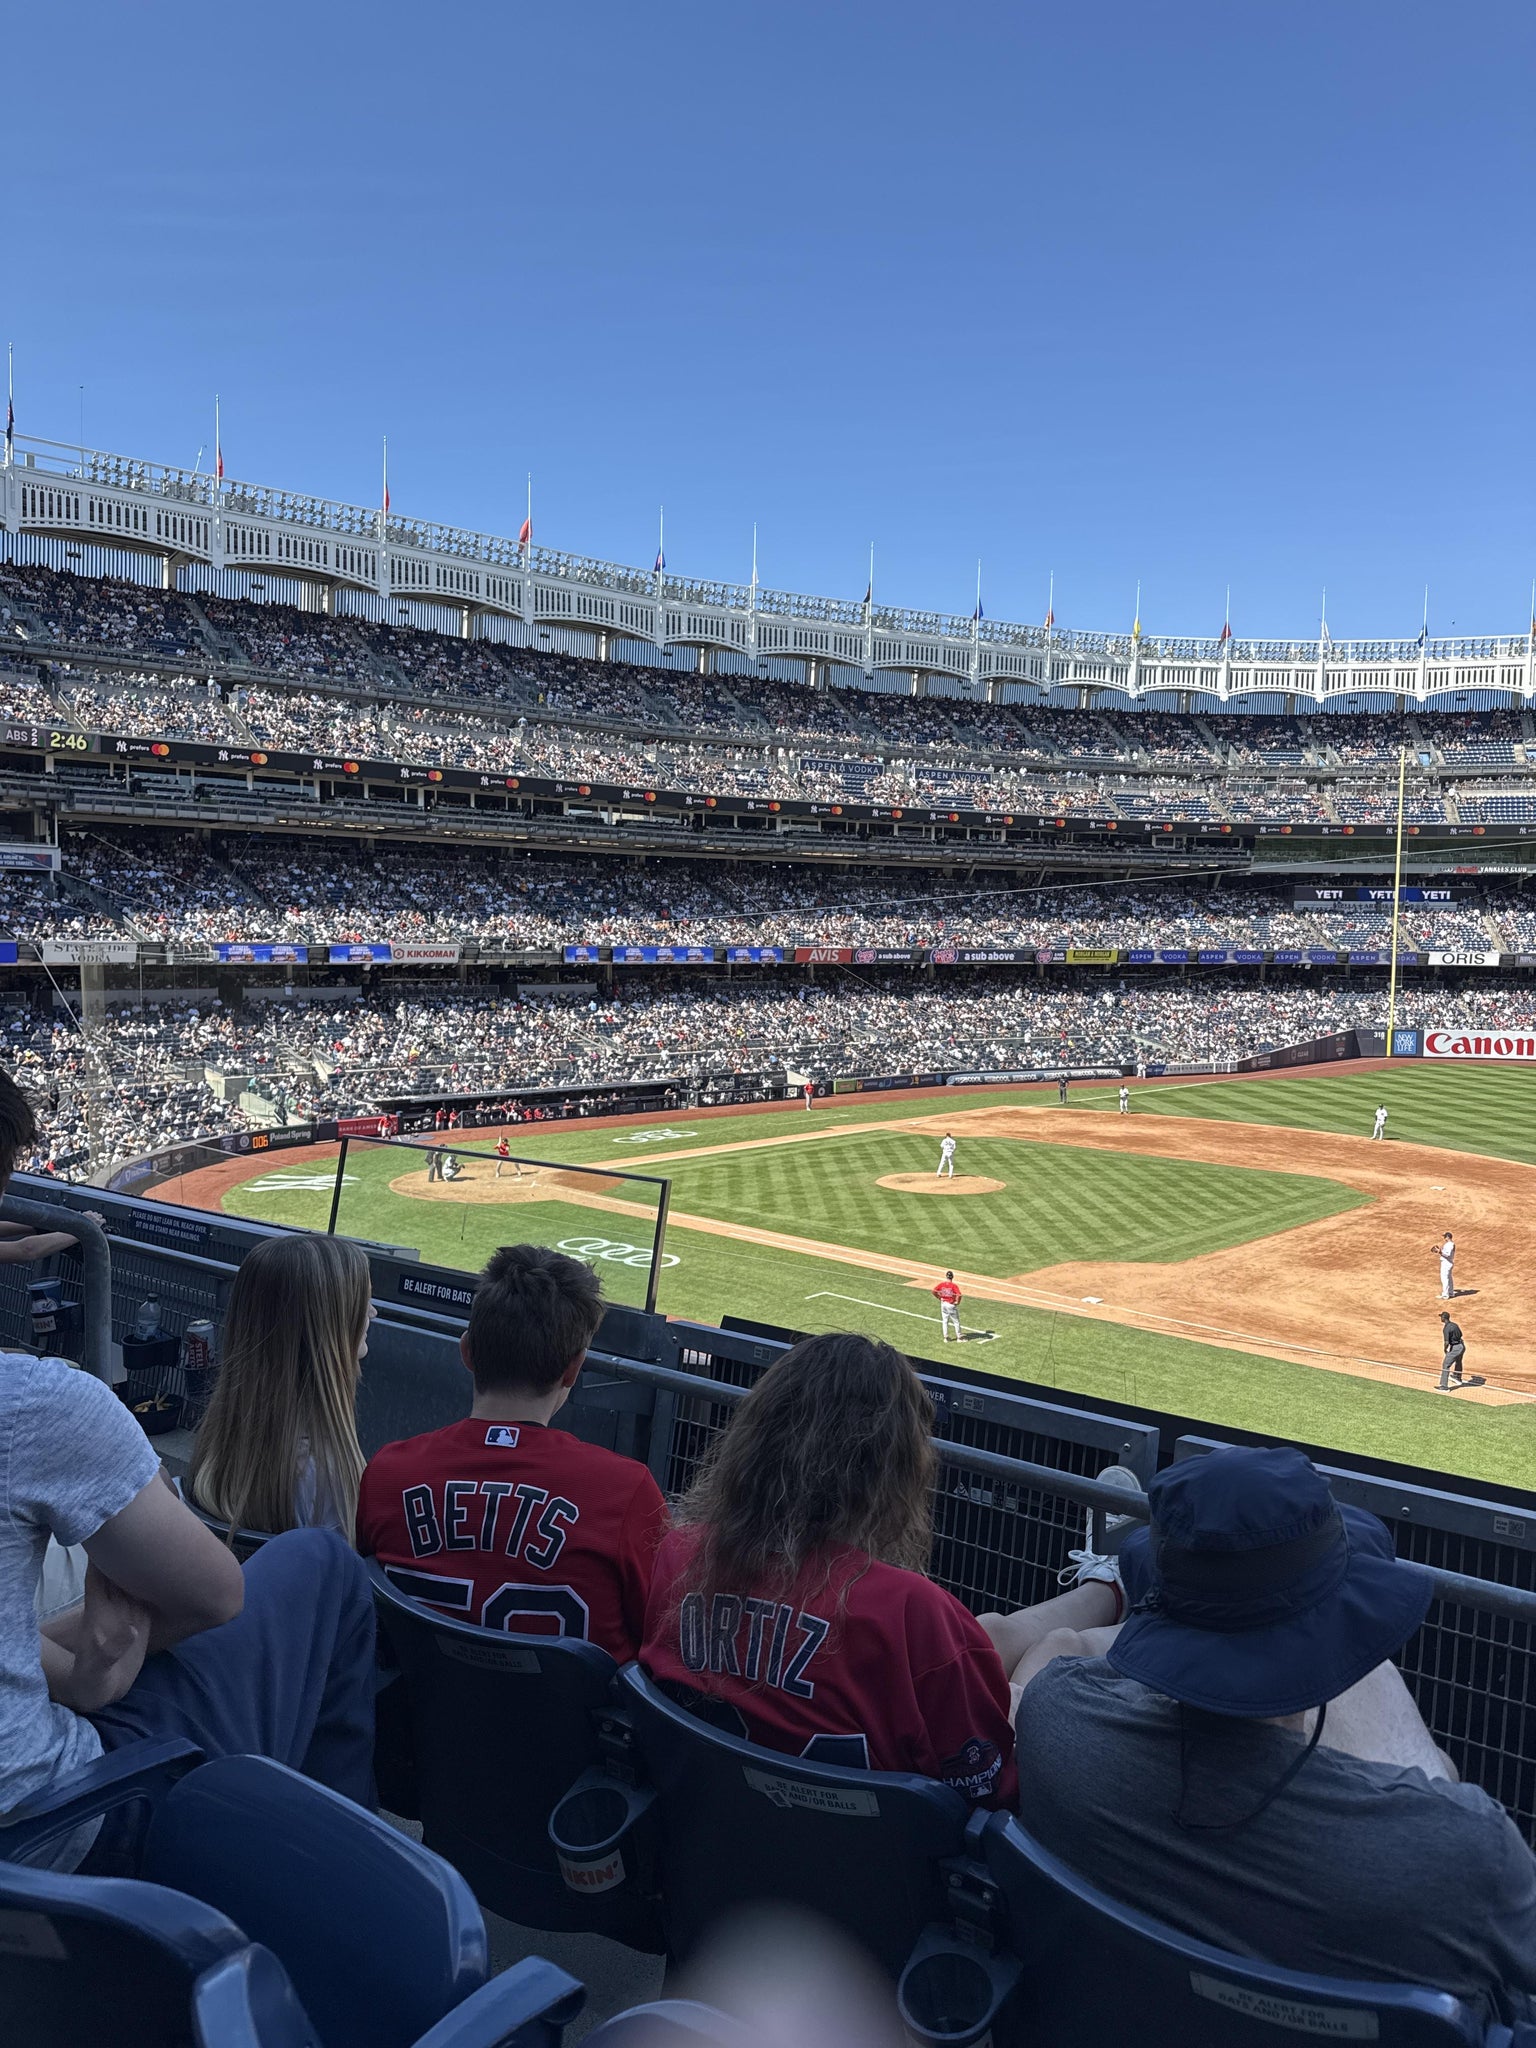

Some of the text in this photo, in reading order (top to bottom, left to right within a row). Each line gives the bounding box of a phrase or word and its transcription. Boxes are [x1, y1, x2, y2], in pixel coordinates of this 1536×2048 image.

[6, 728, 38, 742] ABS 2
[50, 732, 87, 750] 2:46
[31, 737, 38, 747] 2
[804, 761, 879, 774] ASPEN VODKA
[918, 770, 987, 782] ASPEN VODKA
[1316, 890, 1343, 899] YETI
[1369, 890, 1396, 899] YETI
[1422, 890, 1450, 899] YETI
[54, 944, 128, 952] STATEIDE
[407, 950, 455, 958] KIKKOMAN
[71, 953, 111, 962] VODKA
[808, 950, 840, 962] AVIS
[971, 953, 987, 961] sub
[988, 952, 1015, 961] above
[1442, 953, 1485, 964] ORIS
[1426, 1032, 1534, 1056] Canon
[270, 1130, 311, 1142] Poland Spring
[132, 1210, 147, 1220] PLEASE
[153, 1215, 162, 1223] NOT
[181, 1221, 195, 1230] REACH
[155, 1225, 169, 1234] STAND
[403, 1278, 472, 1304] BE ALERT FOR BATS
[195, 1343, 204, 1368] STELL
[402, 1480, 579, 1570] BETTS
[680, 1592, 830, 1699] ORTIZ
[943, 1753, 1002, 1787] HAMPION
[776, 1781, 838, 1800] BE ALERT FOR
[788, 1793, 826, 1807] AND/OR
[828, 1801, 857, 1810] BALLS
[1258, 1999, 1297, 2014] ALERT
[1302, 2008, 1325, 2019] FOR
[1253, 2005, 1306, 2024] AND/OR
[1308, 2018, 1348, 2032] BALLS
